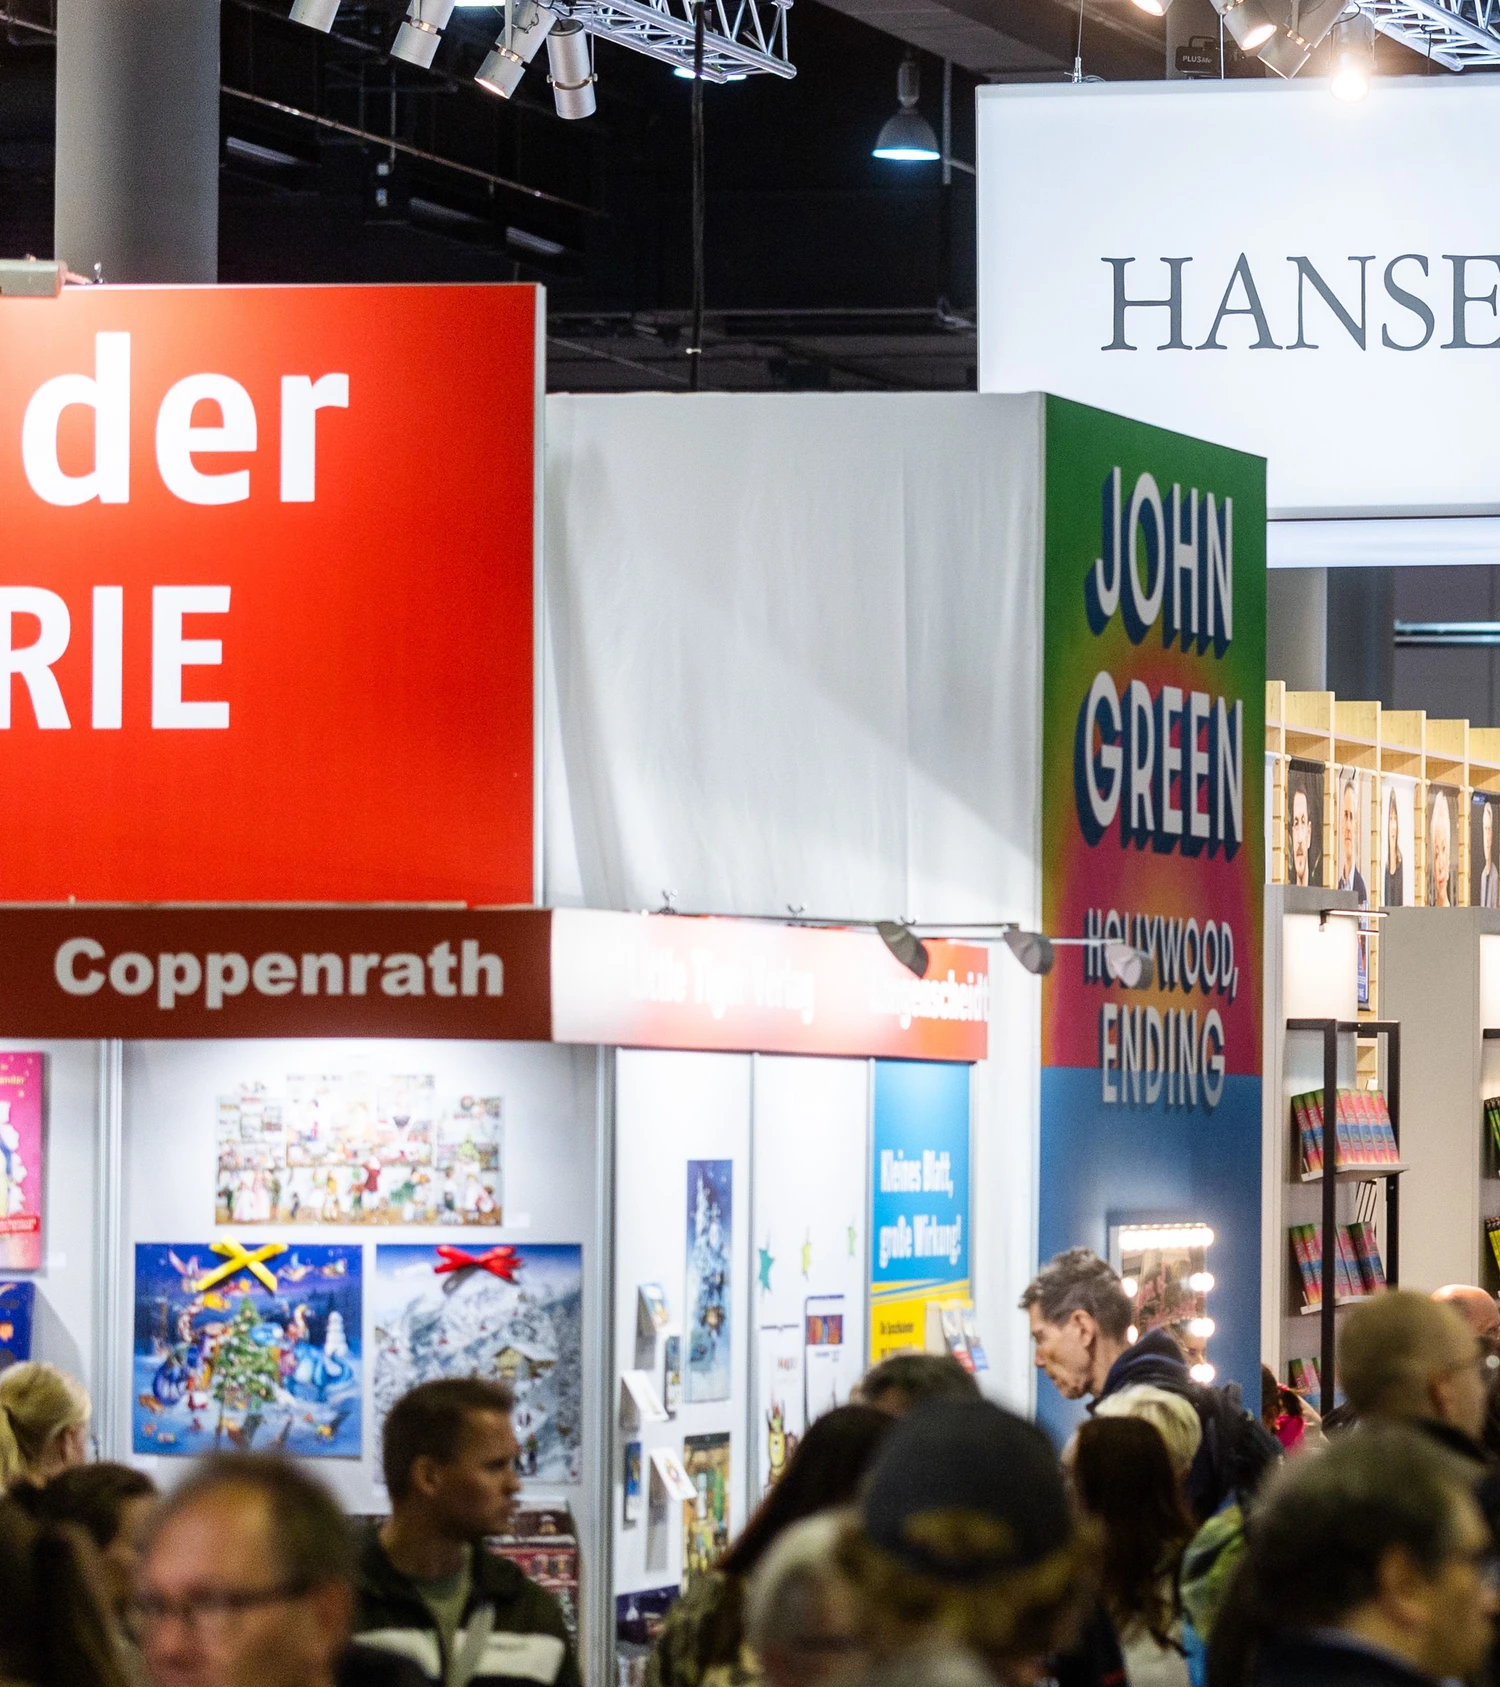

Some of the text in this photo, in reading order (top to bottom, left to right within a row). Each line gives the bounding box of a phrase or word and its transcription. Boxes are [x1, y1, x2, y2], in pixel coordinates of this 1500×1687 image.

[21, 332, 348, 506] der
[1090, 466, 1233, 648] JOHN
[1080, 671, 1243, 850] GREEN
[55, 937, 504, 1010] Coppenrath
[1102, 1003, 1226, 1108] ENDING
[881, 1150, 953, 1199] Kleines Blatt,
[879, 1214, 961, 1269] große Wirkung!
